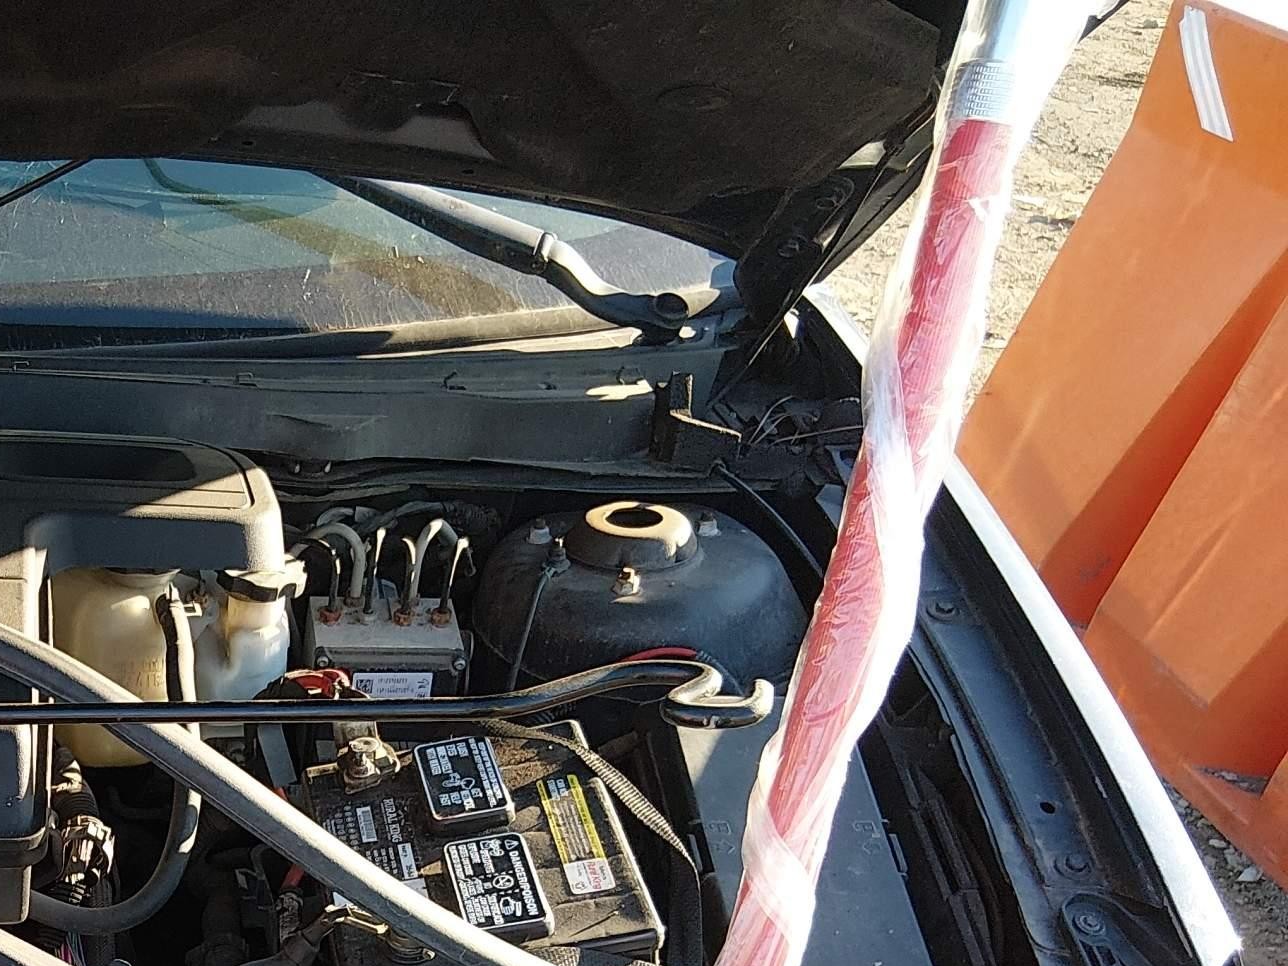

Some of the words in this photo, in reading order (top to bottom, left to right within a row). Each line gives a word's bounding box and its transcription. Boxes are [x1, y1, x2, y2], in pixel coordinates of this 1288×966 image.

[383, 797, 398, 823] RURAL
[388, 823, 402, 843] KING
[508, 849, 538, 916] DANGER/POISON
